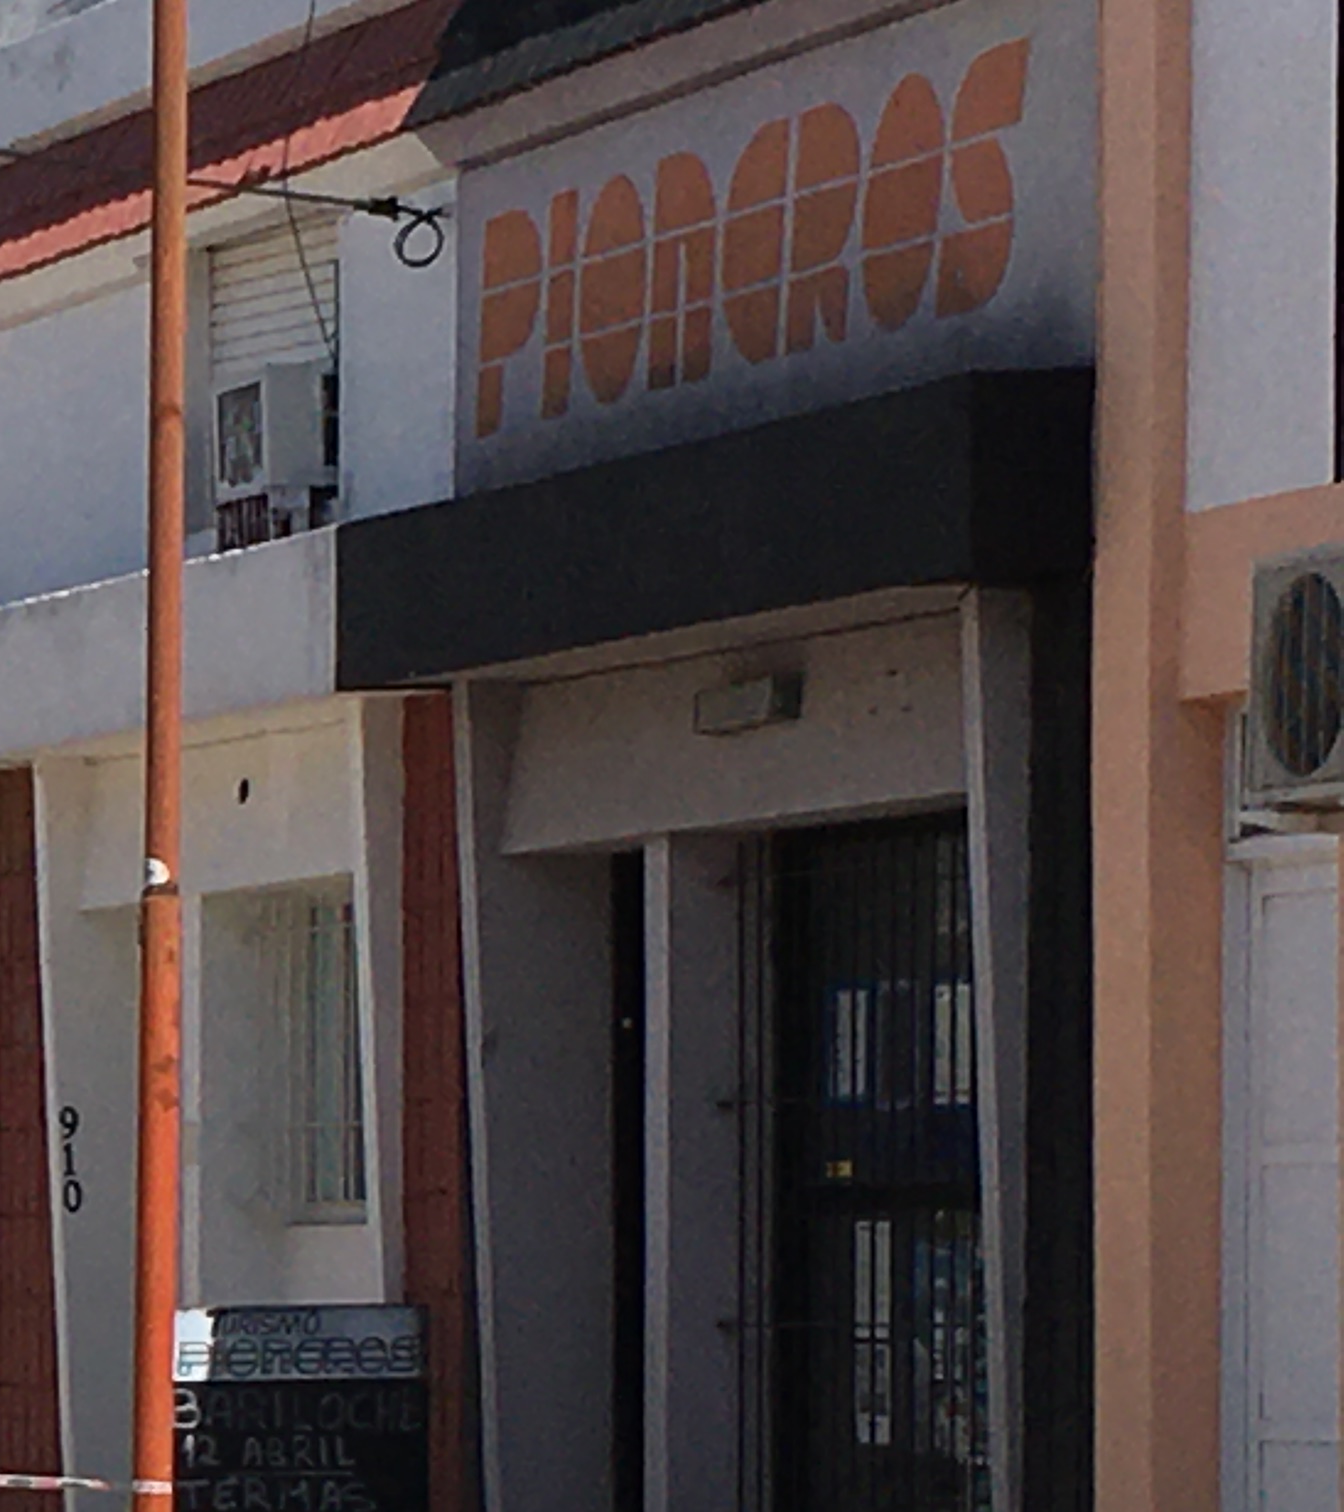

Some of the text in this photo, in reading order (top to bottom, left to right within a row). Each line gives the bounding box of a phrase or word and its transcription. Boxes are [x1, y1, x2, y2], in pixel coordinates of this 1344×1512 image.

[58, 1105, 83, 1213] 910
[181, 1433, 356, 1468] 12 ABRIL
